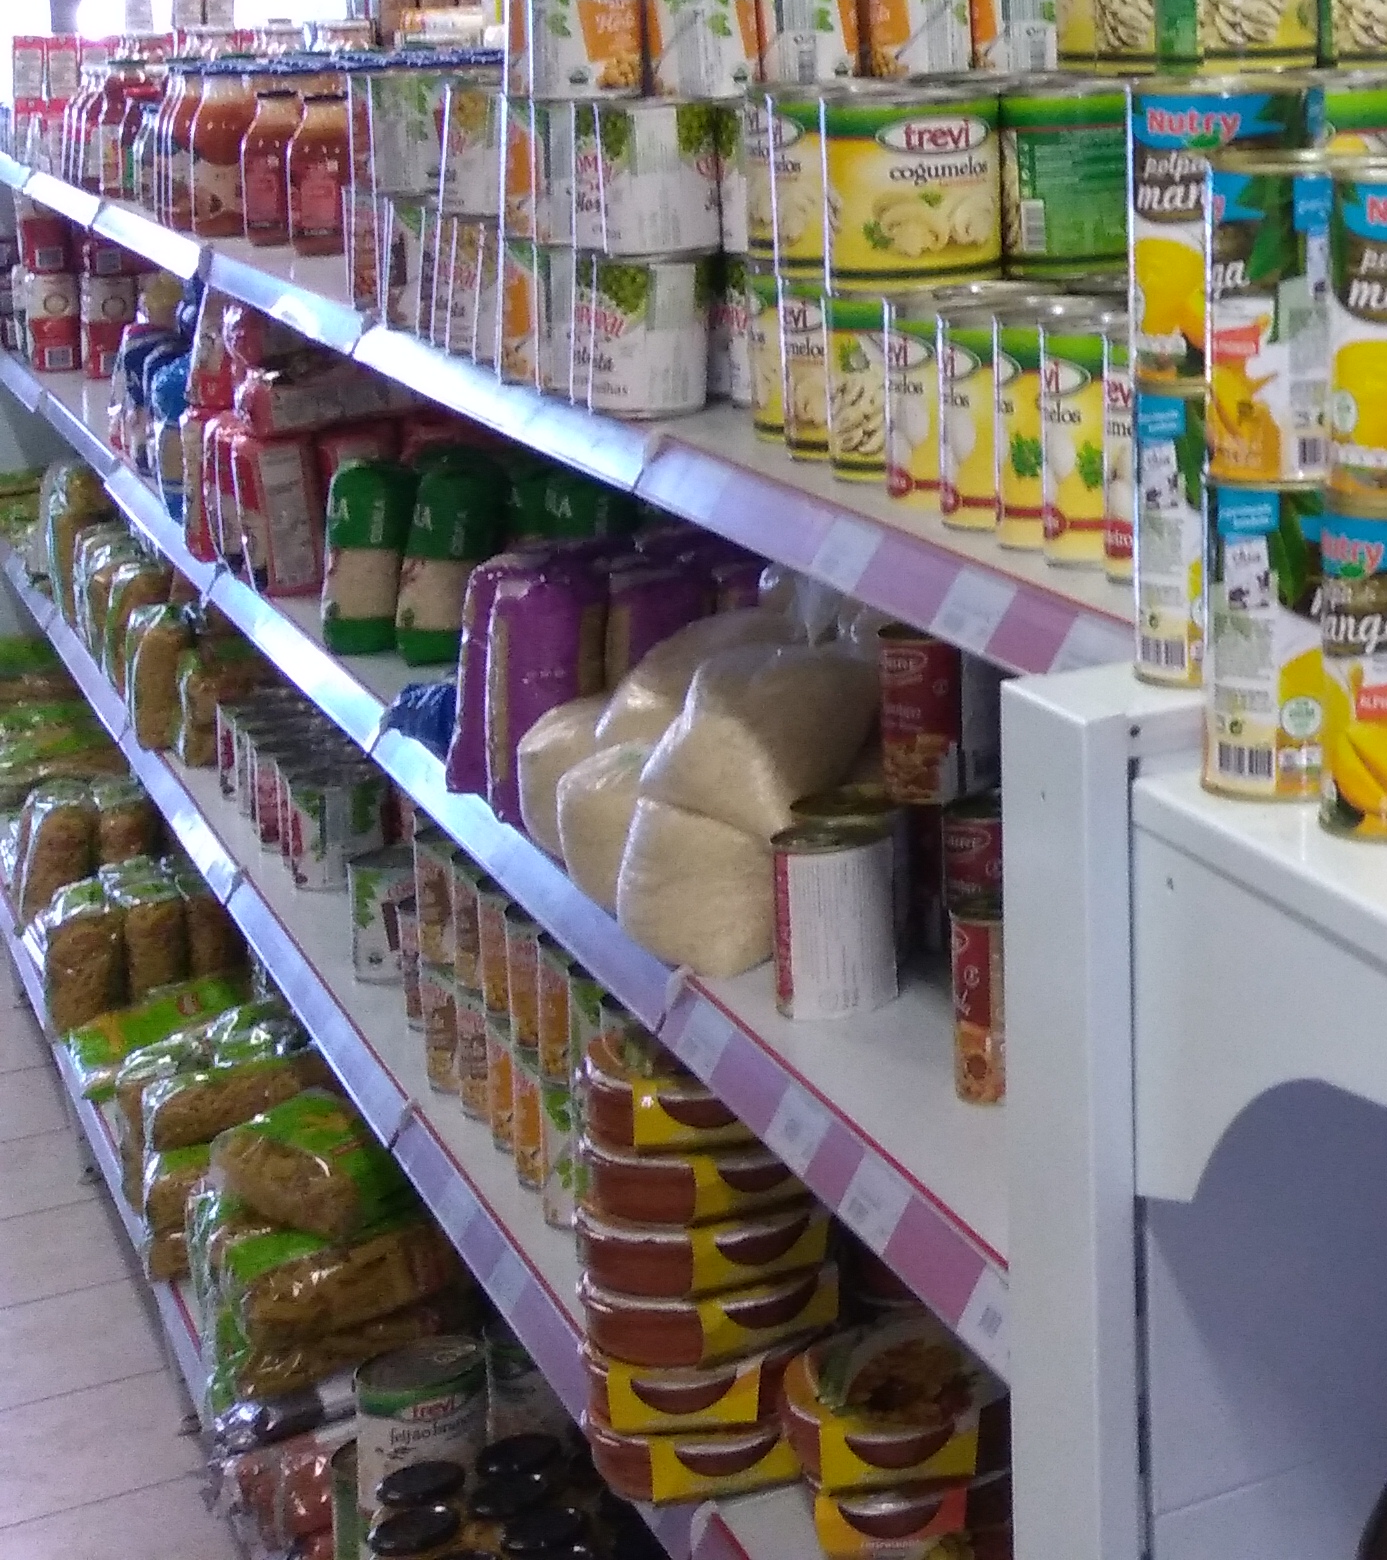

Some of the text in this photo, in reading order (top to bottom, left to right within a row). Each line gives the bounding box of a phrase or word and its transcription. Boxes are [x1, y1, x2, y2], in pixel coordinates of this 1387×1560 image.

[903, 118, 970, 151] trevi
[1146, 107, 1241, 143] Nutry
[889, 155, 989, 186] cogumelos
